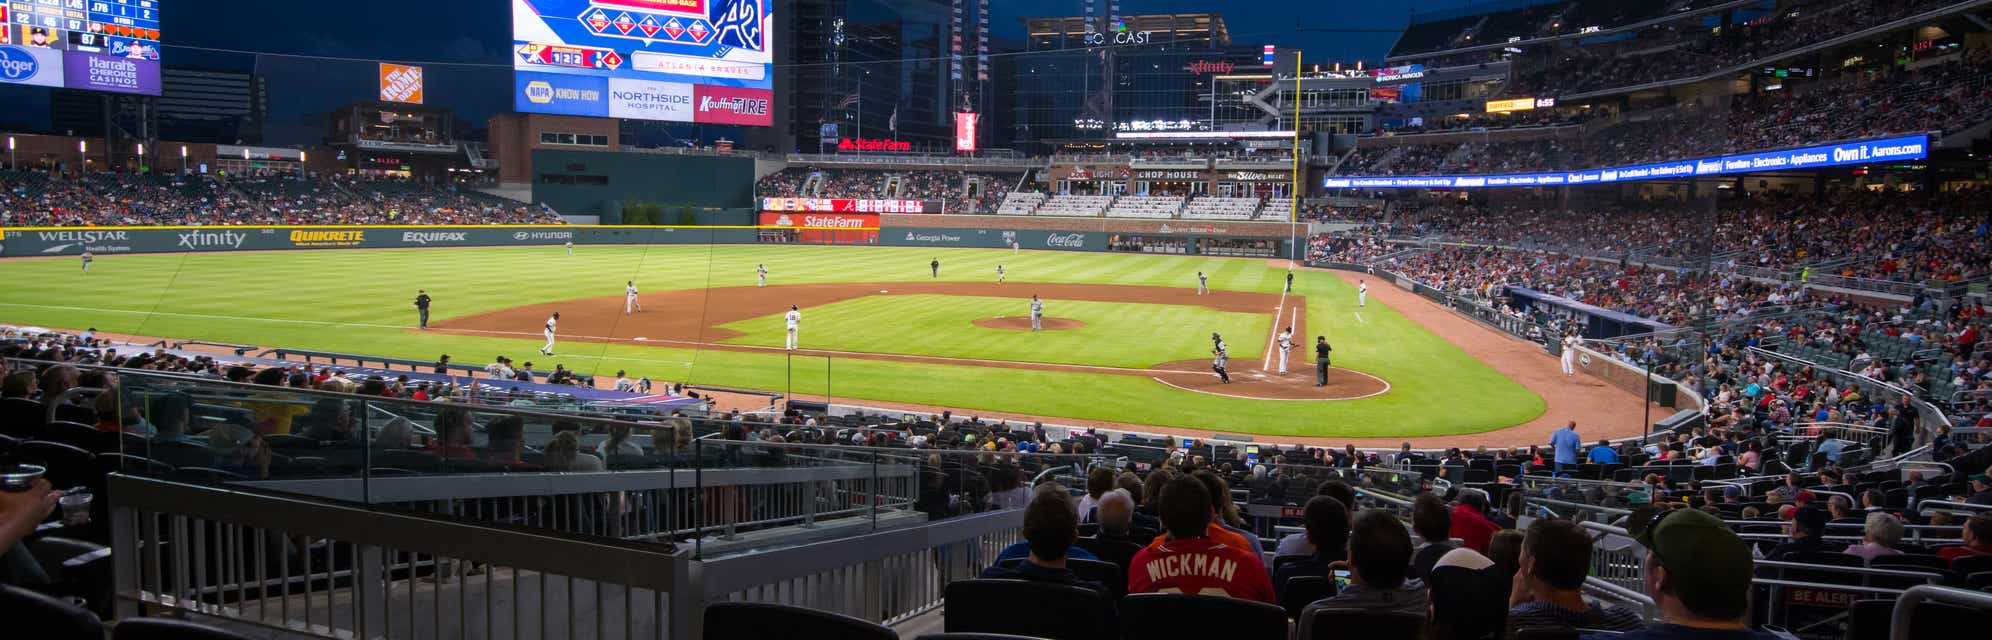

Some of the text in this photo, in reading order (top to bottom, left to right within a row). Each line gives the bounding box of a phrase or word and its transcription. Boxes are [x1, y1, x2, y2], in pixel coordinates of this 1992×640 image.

[16, 13, 30, 23] 22
[143, 9, 151, 18] 2
[1084, 31, 1152, 44] OCAST
[88, 56, 137, 70] Harrah's
[1190, 60, 1234, 76] xfinity
[89, 68, 137, 79] CHEROKEE
[90, 76, 137, 85] CASINOS
[382, 66, 421, 101] HOME
[529, 87, 600, 102] NAPA KNOW HOW
[613, 91, 690, 105] NORTHSIDE
[628, 103, 676, 113] HOSPITAL
[733, 98, 767, 115] TIRE
[1834, 144, 1922, 162] Own it. Aarons.com
[1753, 157, 1787, 168] Electronics
[1790, 153, 1828, 165] Appliances
[1167, 171, 1199, 179] HOUSE
[39, 230, 127, 243] WELLSTAR
[178, 229, 246, 249] xfinity
[290, 230, 364, 241] QUIKRETE
[402, 232, 467, 244] EQUIFAX
[531, 231, 573, 239] HYUNDAI
[916, 234, 961, 242] Georgia Power
[1146, 553, 1238, 583] WICKMAN
[1794, 590, 1857, 607] BE ALERT
